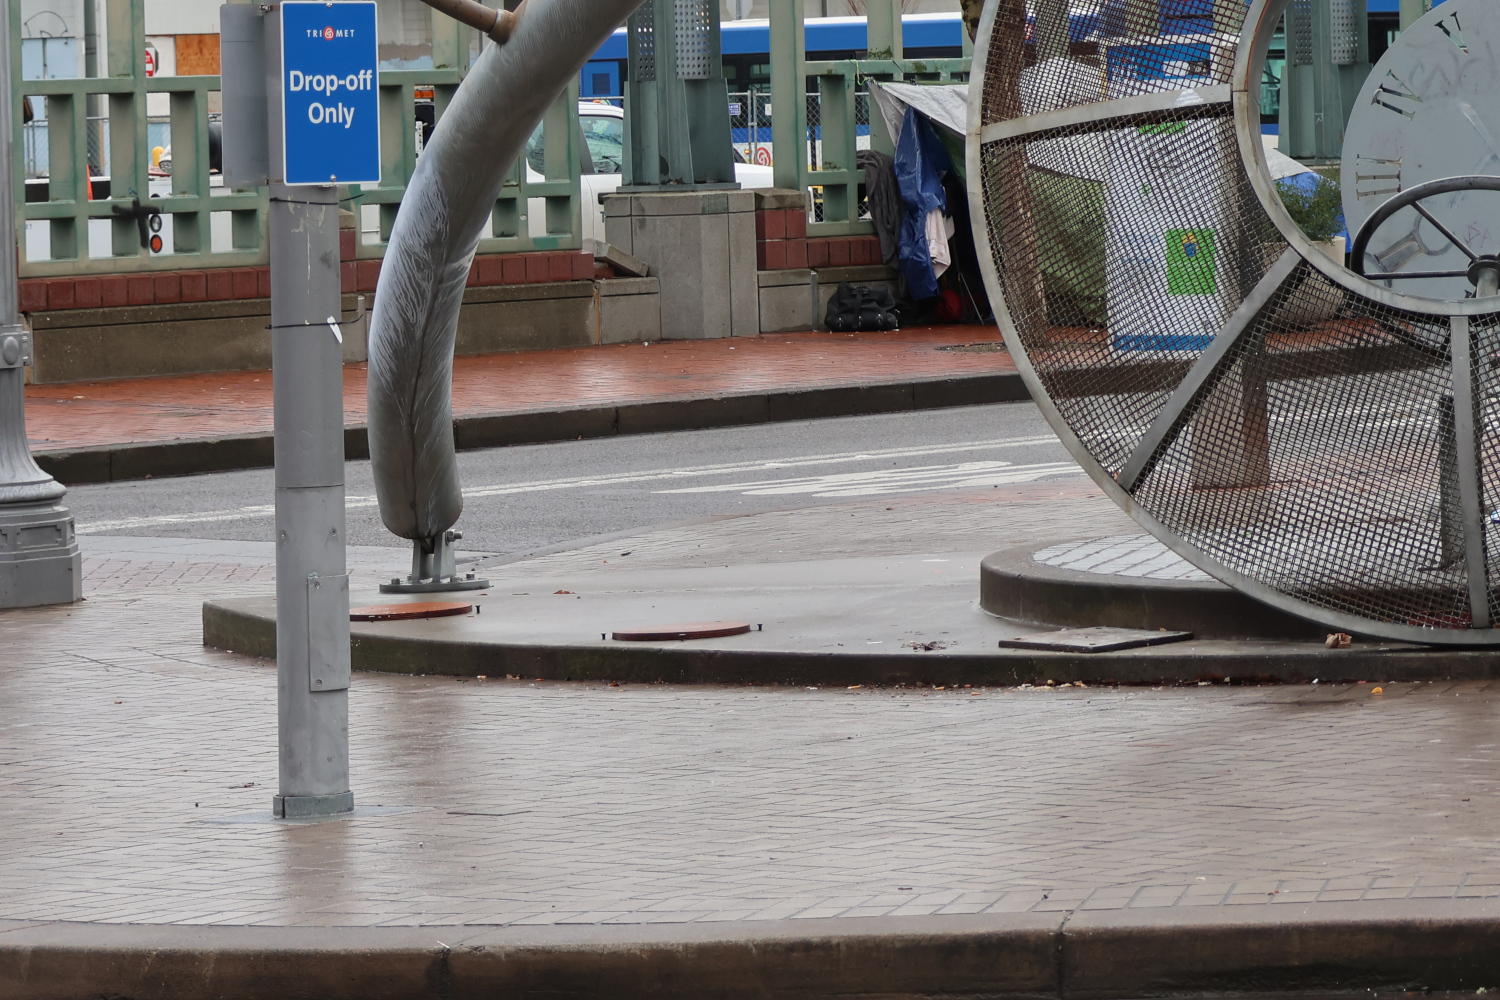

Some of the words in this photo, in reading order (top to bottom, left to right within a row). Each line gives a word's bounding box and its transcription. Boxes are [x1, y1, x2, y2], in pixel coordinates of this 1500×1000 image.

[1434, 11, 1470, 56] V
[289, 69, 373, 97] Drop-off
[1371, 69, 1423, 121] IV
[308, 102, 355, 129] Only
